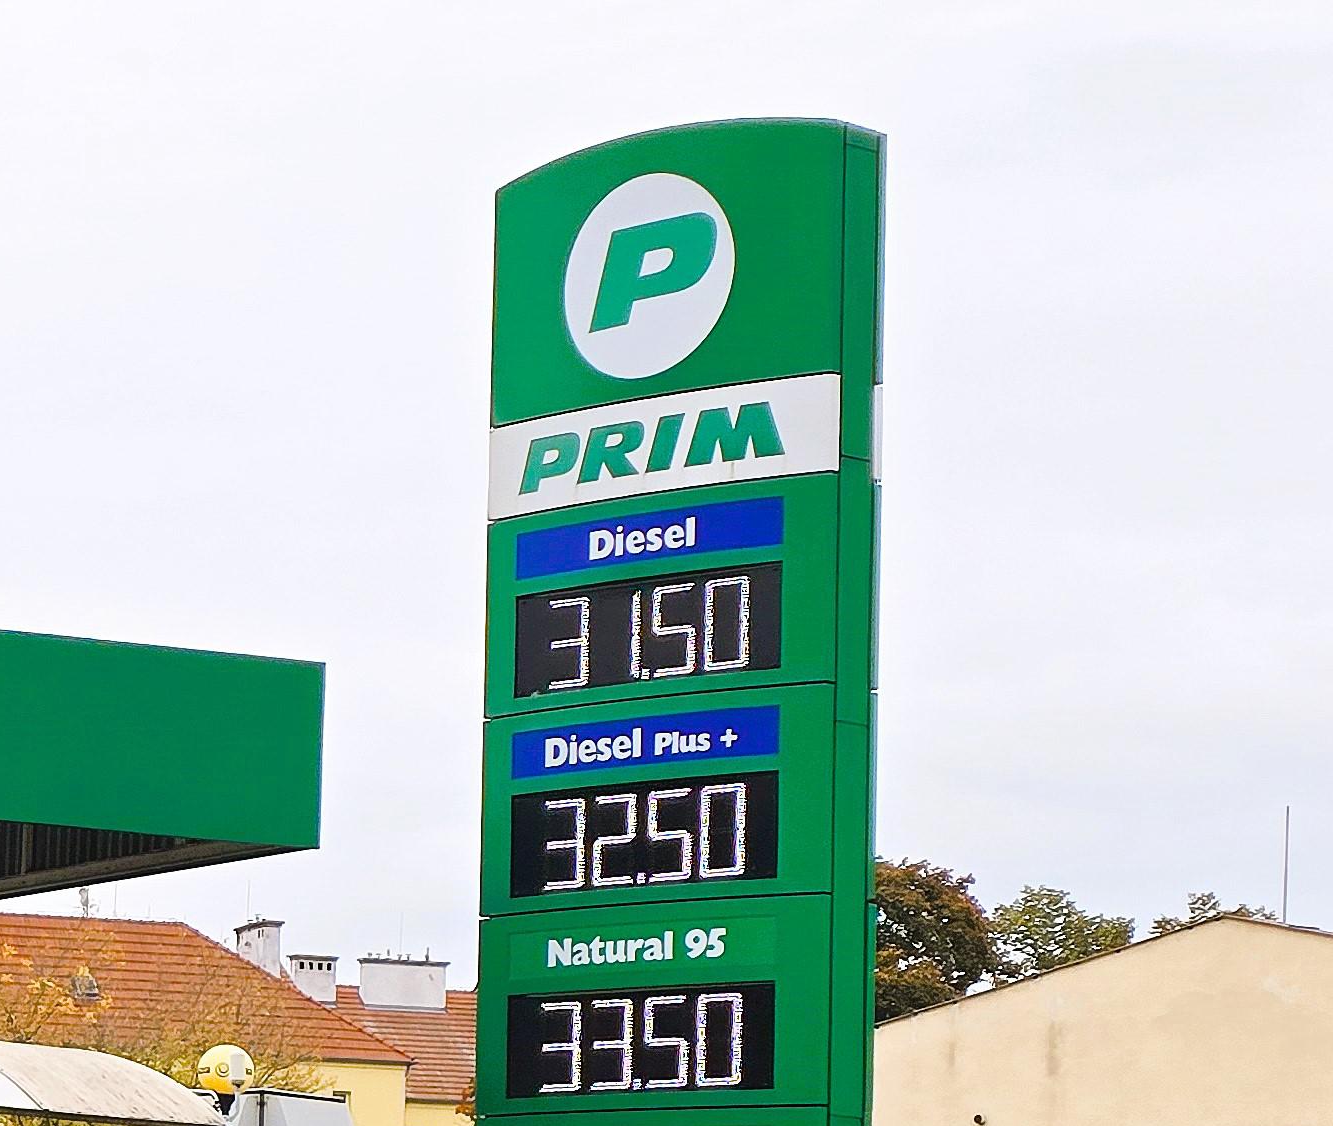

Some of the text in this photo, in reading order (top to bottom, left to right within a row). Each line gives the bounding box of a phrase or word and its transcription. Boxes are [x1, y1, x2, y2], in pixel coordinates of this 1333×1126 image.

[588, 211, 718, 334] P
[518, 401, 786, 496] PRIM
[588, 516, 697, 561] Diesel
[544, 727, 642, 768] Diesel
[654, 730, 711, 756] Plus
[542, 782, 748, 891] 32.50
[547, 927, 727, 968] Natural 95
[538, 992, 744, 1093] 33.50
